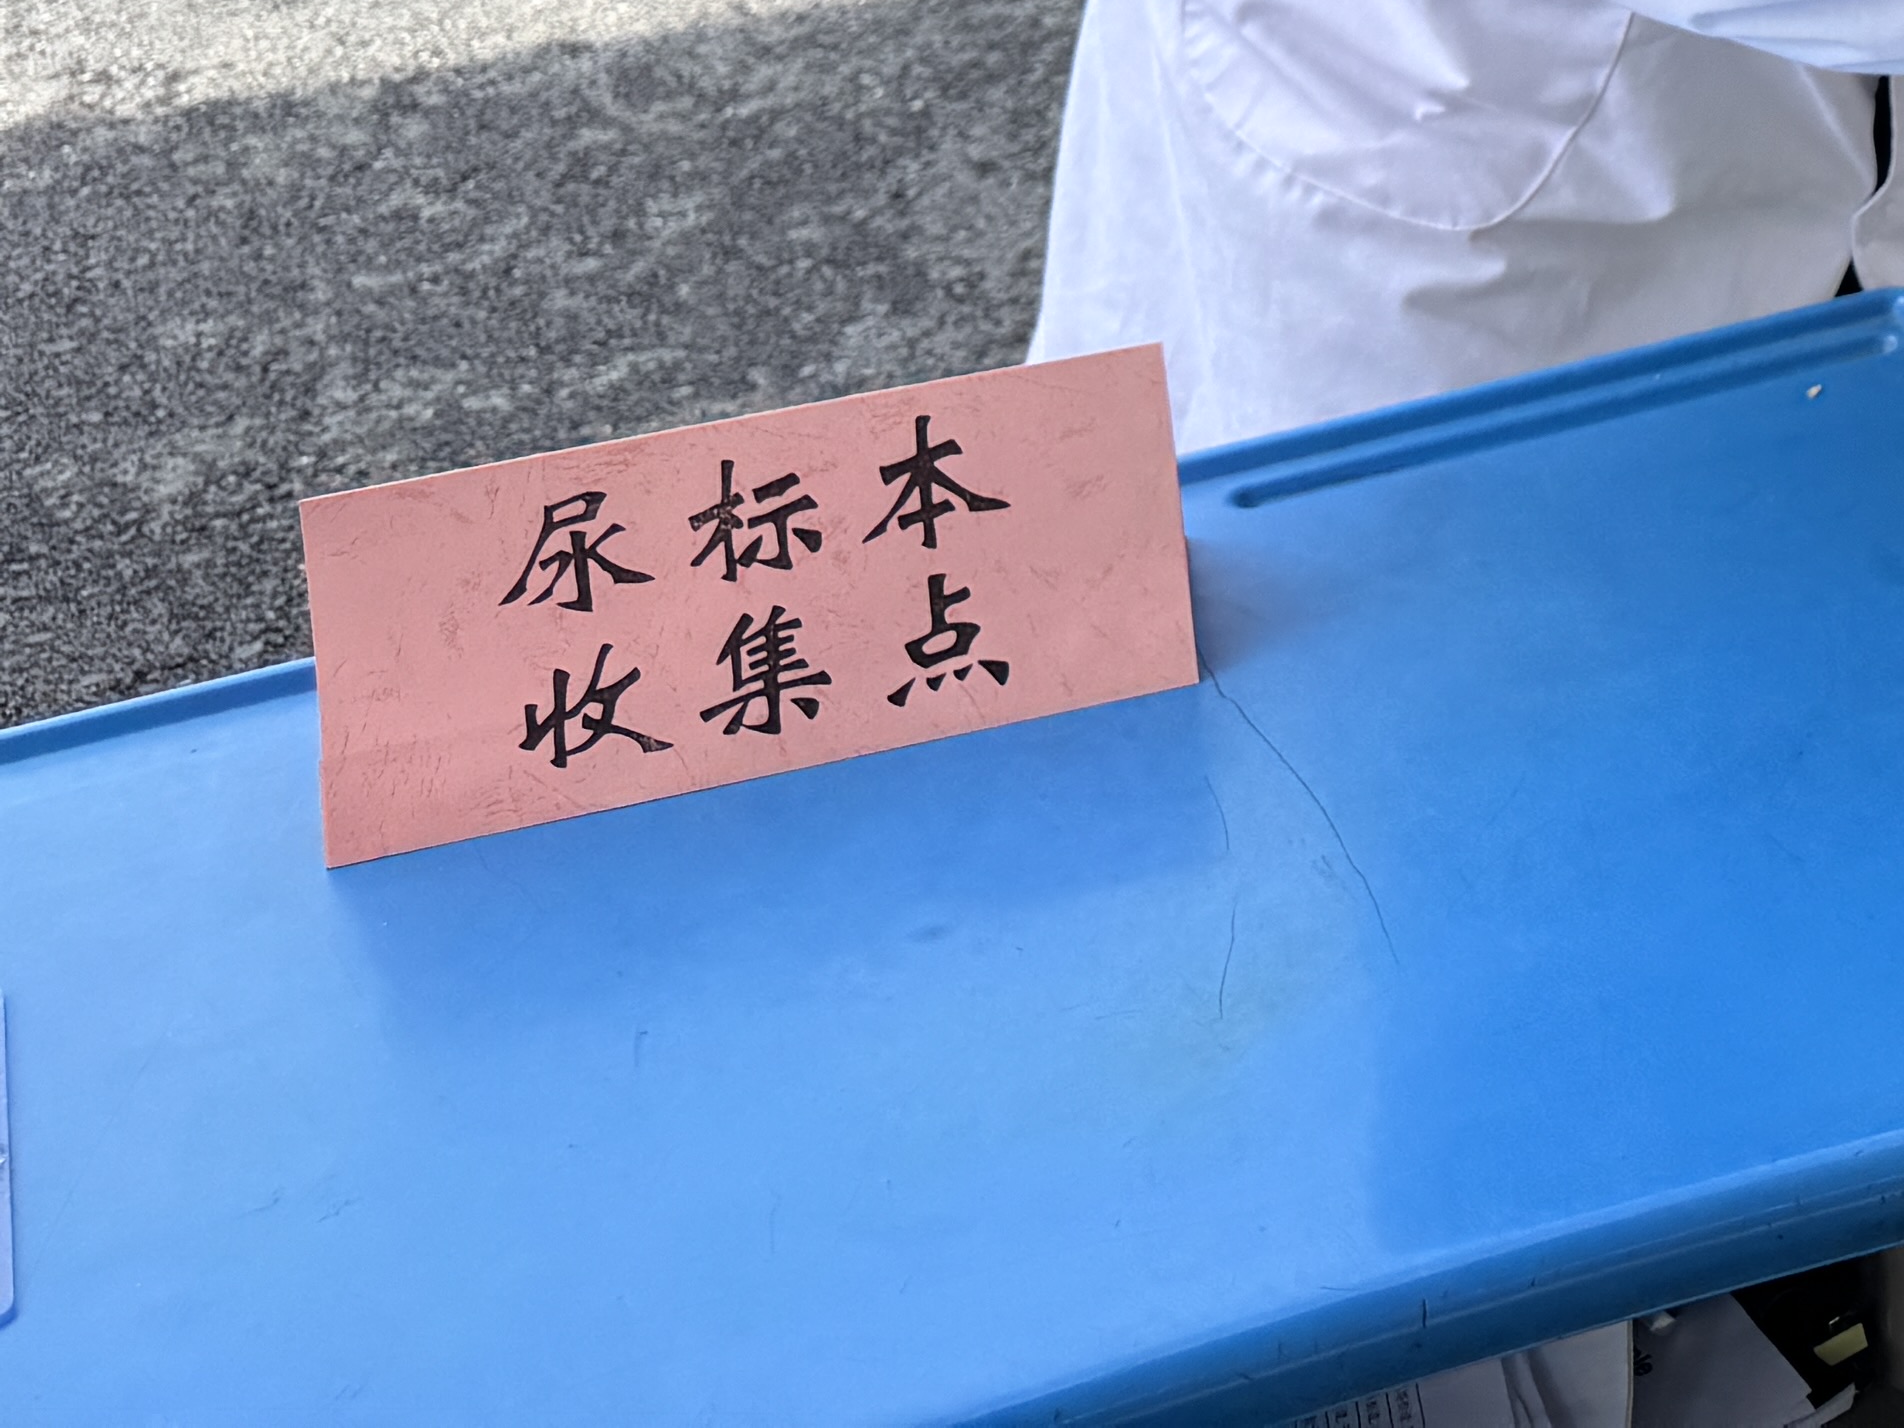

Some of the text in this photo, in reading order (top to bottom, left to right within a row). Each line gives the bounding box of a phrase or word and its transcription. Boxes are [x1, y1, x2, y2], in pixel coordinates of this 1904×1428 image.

[498, 415, 1011, 613] 尿标本
[518, 573, 1011, 768] 收集点
